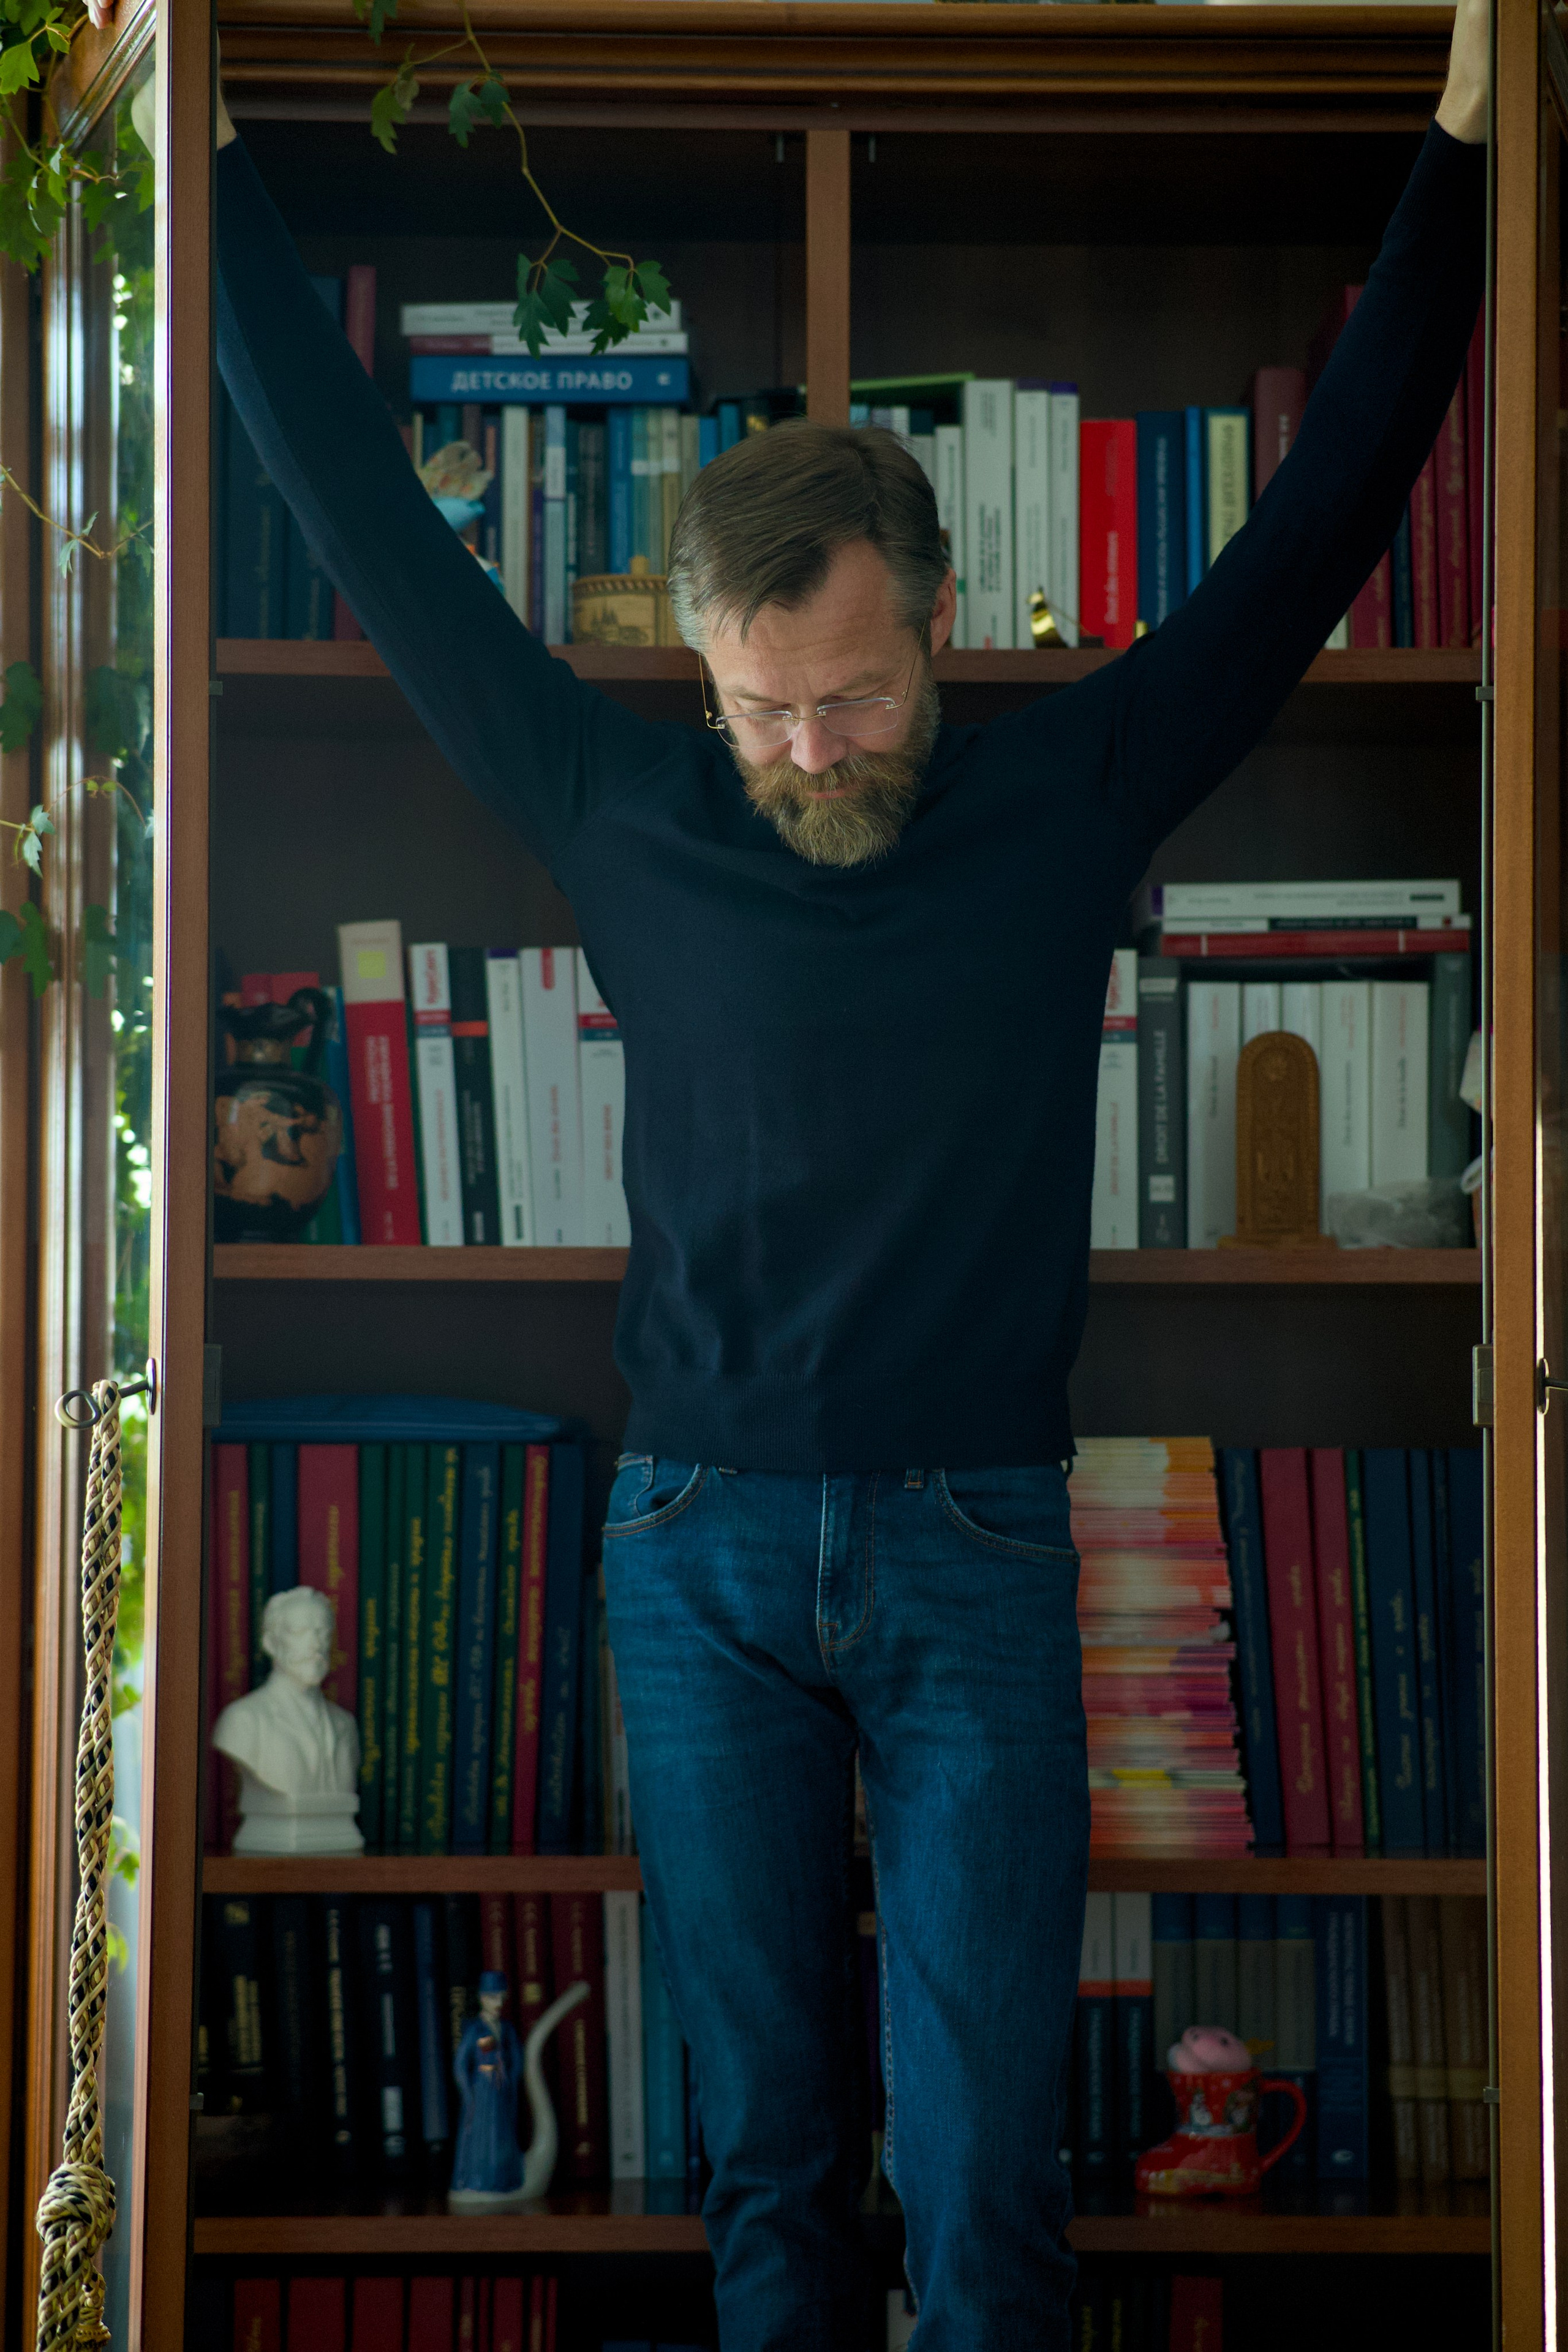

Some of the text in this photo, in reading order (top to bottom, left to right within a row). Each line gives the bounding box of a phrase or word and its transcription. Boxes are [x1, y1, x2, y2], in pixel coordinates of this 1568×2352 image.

[450, 371, 633, 393] ДЕТСКОЕ ПРАВО
[1153, 1030, 1169, 1164] DROIT DE LA FAMILLE
